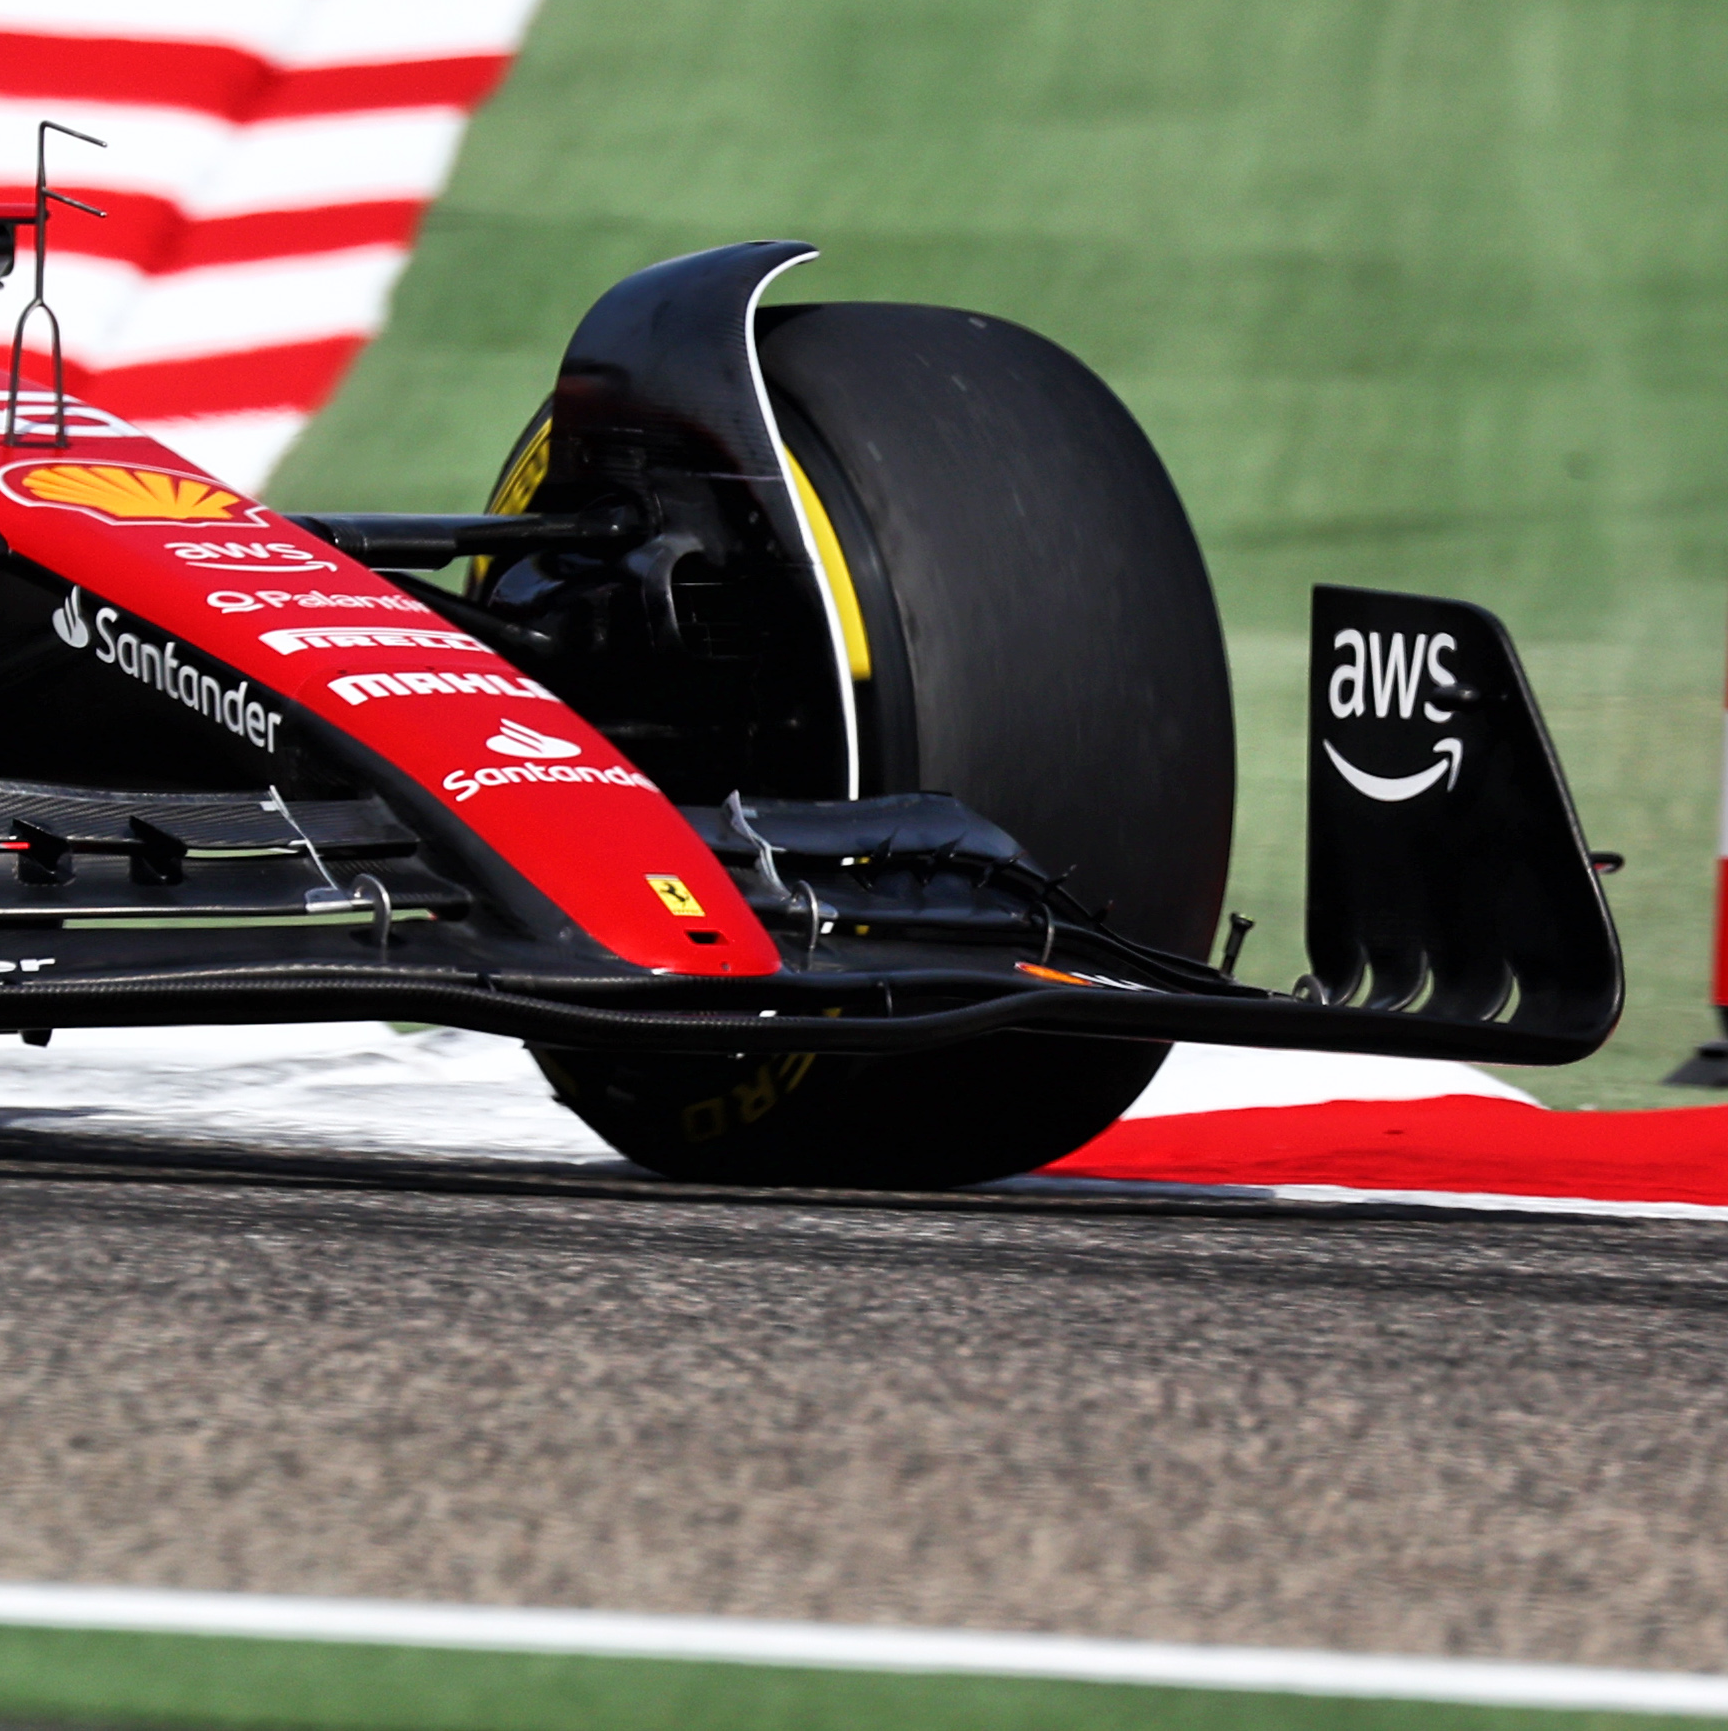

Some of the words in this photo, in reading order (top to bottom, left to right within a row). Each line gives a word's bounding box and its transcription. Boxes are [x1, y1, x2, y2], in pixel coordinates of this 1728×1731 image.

[165, 541, 315, 561] aws
[95, 607, 283, 754] Santander
[1328, 628, 1458, 723] aws
[443, 761, 661, 802] Santande
